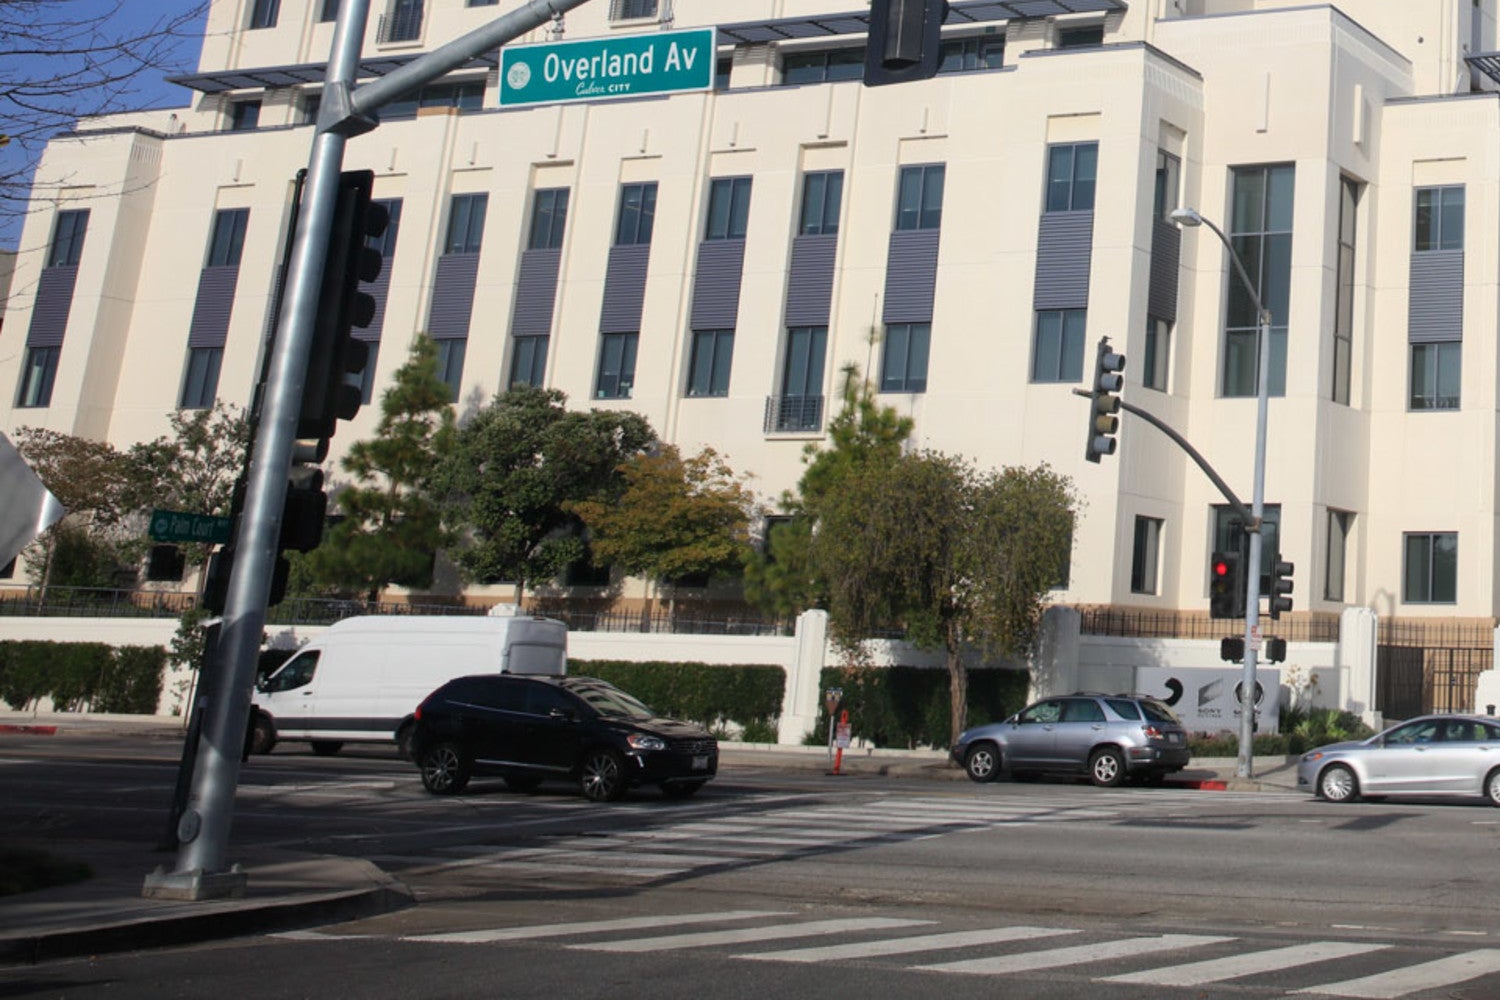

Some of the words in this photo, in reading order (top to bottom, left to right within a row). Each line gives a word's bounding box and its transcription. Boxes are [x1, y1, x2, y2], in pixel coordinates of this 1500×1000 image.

[543, 44, 654, 83] Overland
[664, 42, 698, 72] Av
[608, 83, 632, 93] CITY
